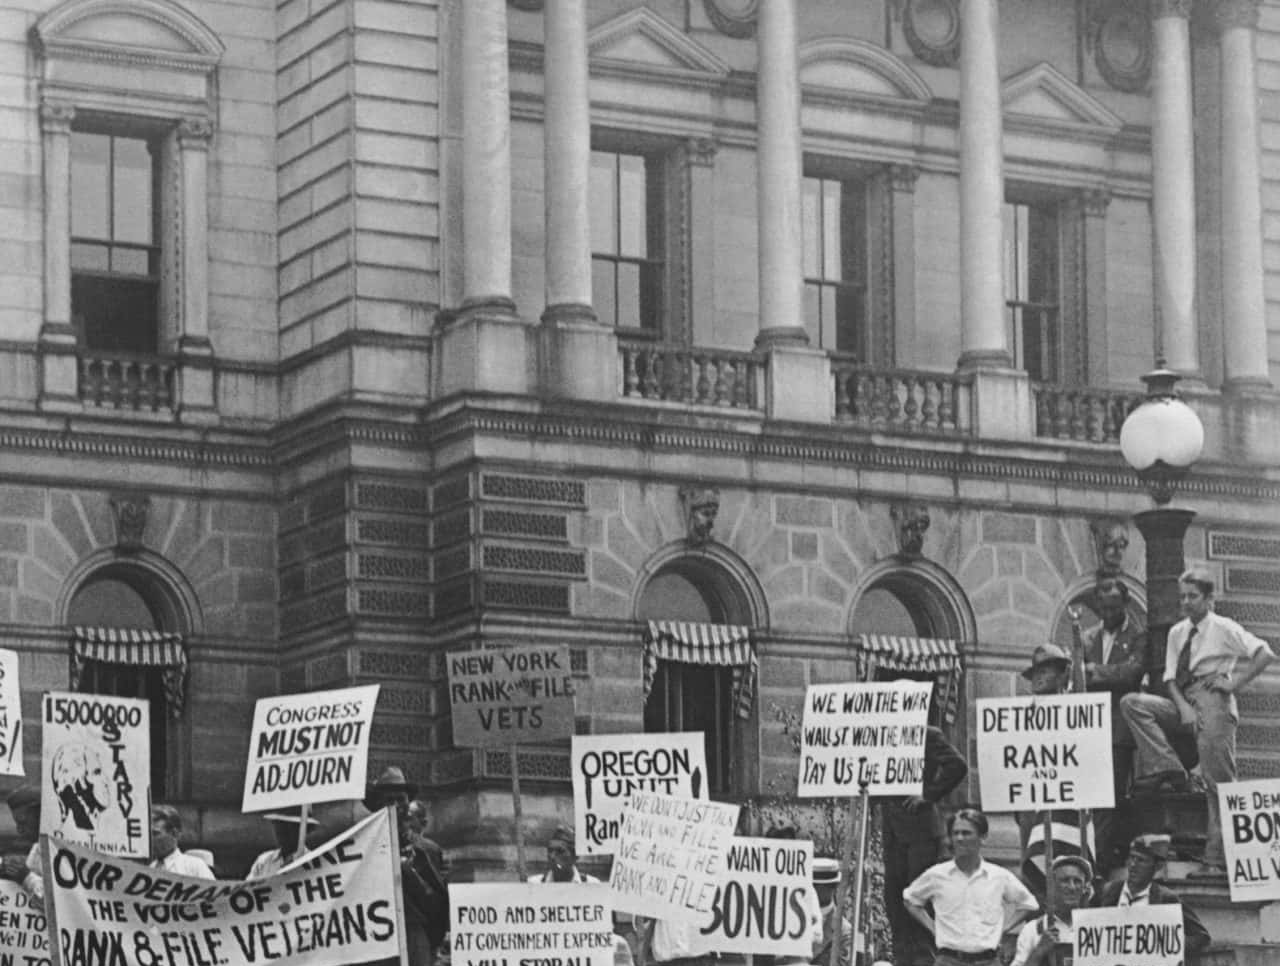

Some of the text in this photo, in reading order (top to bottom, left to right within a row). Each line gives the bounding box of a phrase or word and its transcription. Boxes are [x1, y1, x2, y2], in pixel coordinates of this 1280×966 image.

[452, 651, 561, 675] NEW YORK
[452, 677, 576, 704] RANK FILE
[812, 691, 928, 714] WE WON THE WAR
[266, 701, 362, 727] CONGRESS
[478, 706, 542, 731] VETS
[983, 703, 1104, 732] DETROIT UNIT
[257, 720, 366, 758] MUST NOT
[581, 748, 690, 778] OREGON
[1004, 744, 1079, 768] RANK
[252, 755, 353, 794] ADJOURN
[803, 756, 826, 784] PAY
[1032, 768, 1057, 780] AND
[604, 777, 679, 798] UNIT
[1009, 781, 1074, 803] FILE
[1226, 794, 1246, 811] WE
[53, 848, 122, 890] OUR
[727, 845, 807, 877] WANT OUR
[1234, 857, 1270, 882] ALL
[87, 873, 344, 924] THE VOICE OF THE
[25, 913, 47, 932] TO
[457, 904, 604, 924] FOOD AND SHELTER
[231, 900, 395, 963] VETERANS
[454, 931, 613, 951] AT GOVERNMENT EXPENSE
[1078, 923, 1182, 958] PAY THE BONUS
